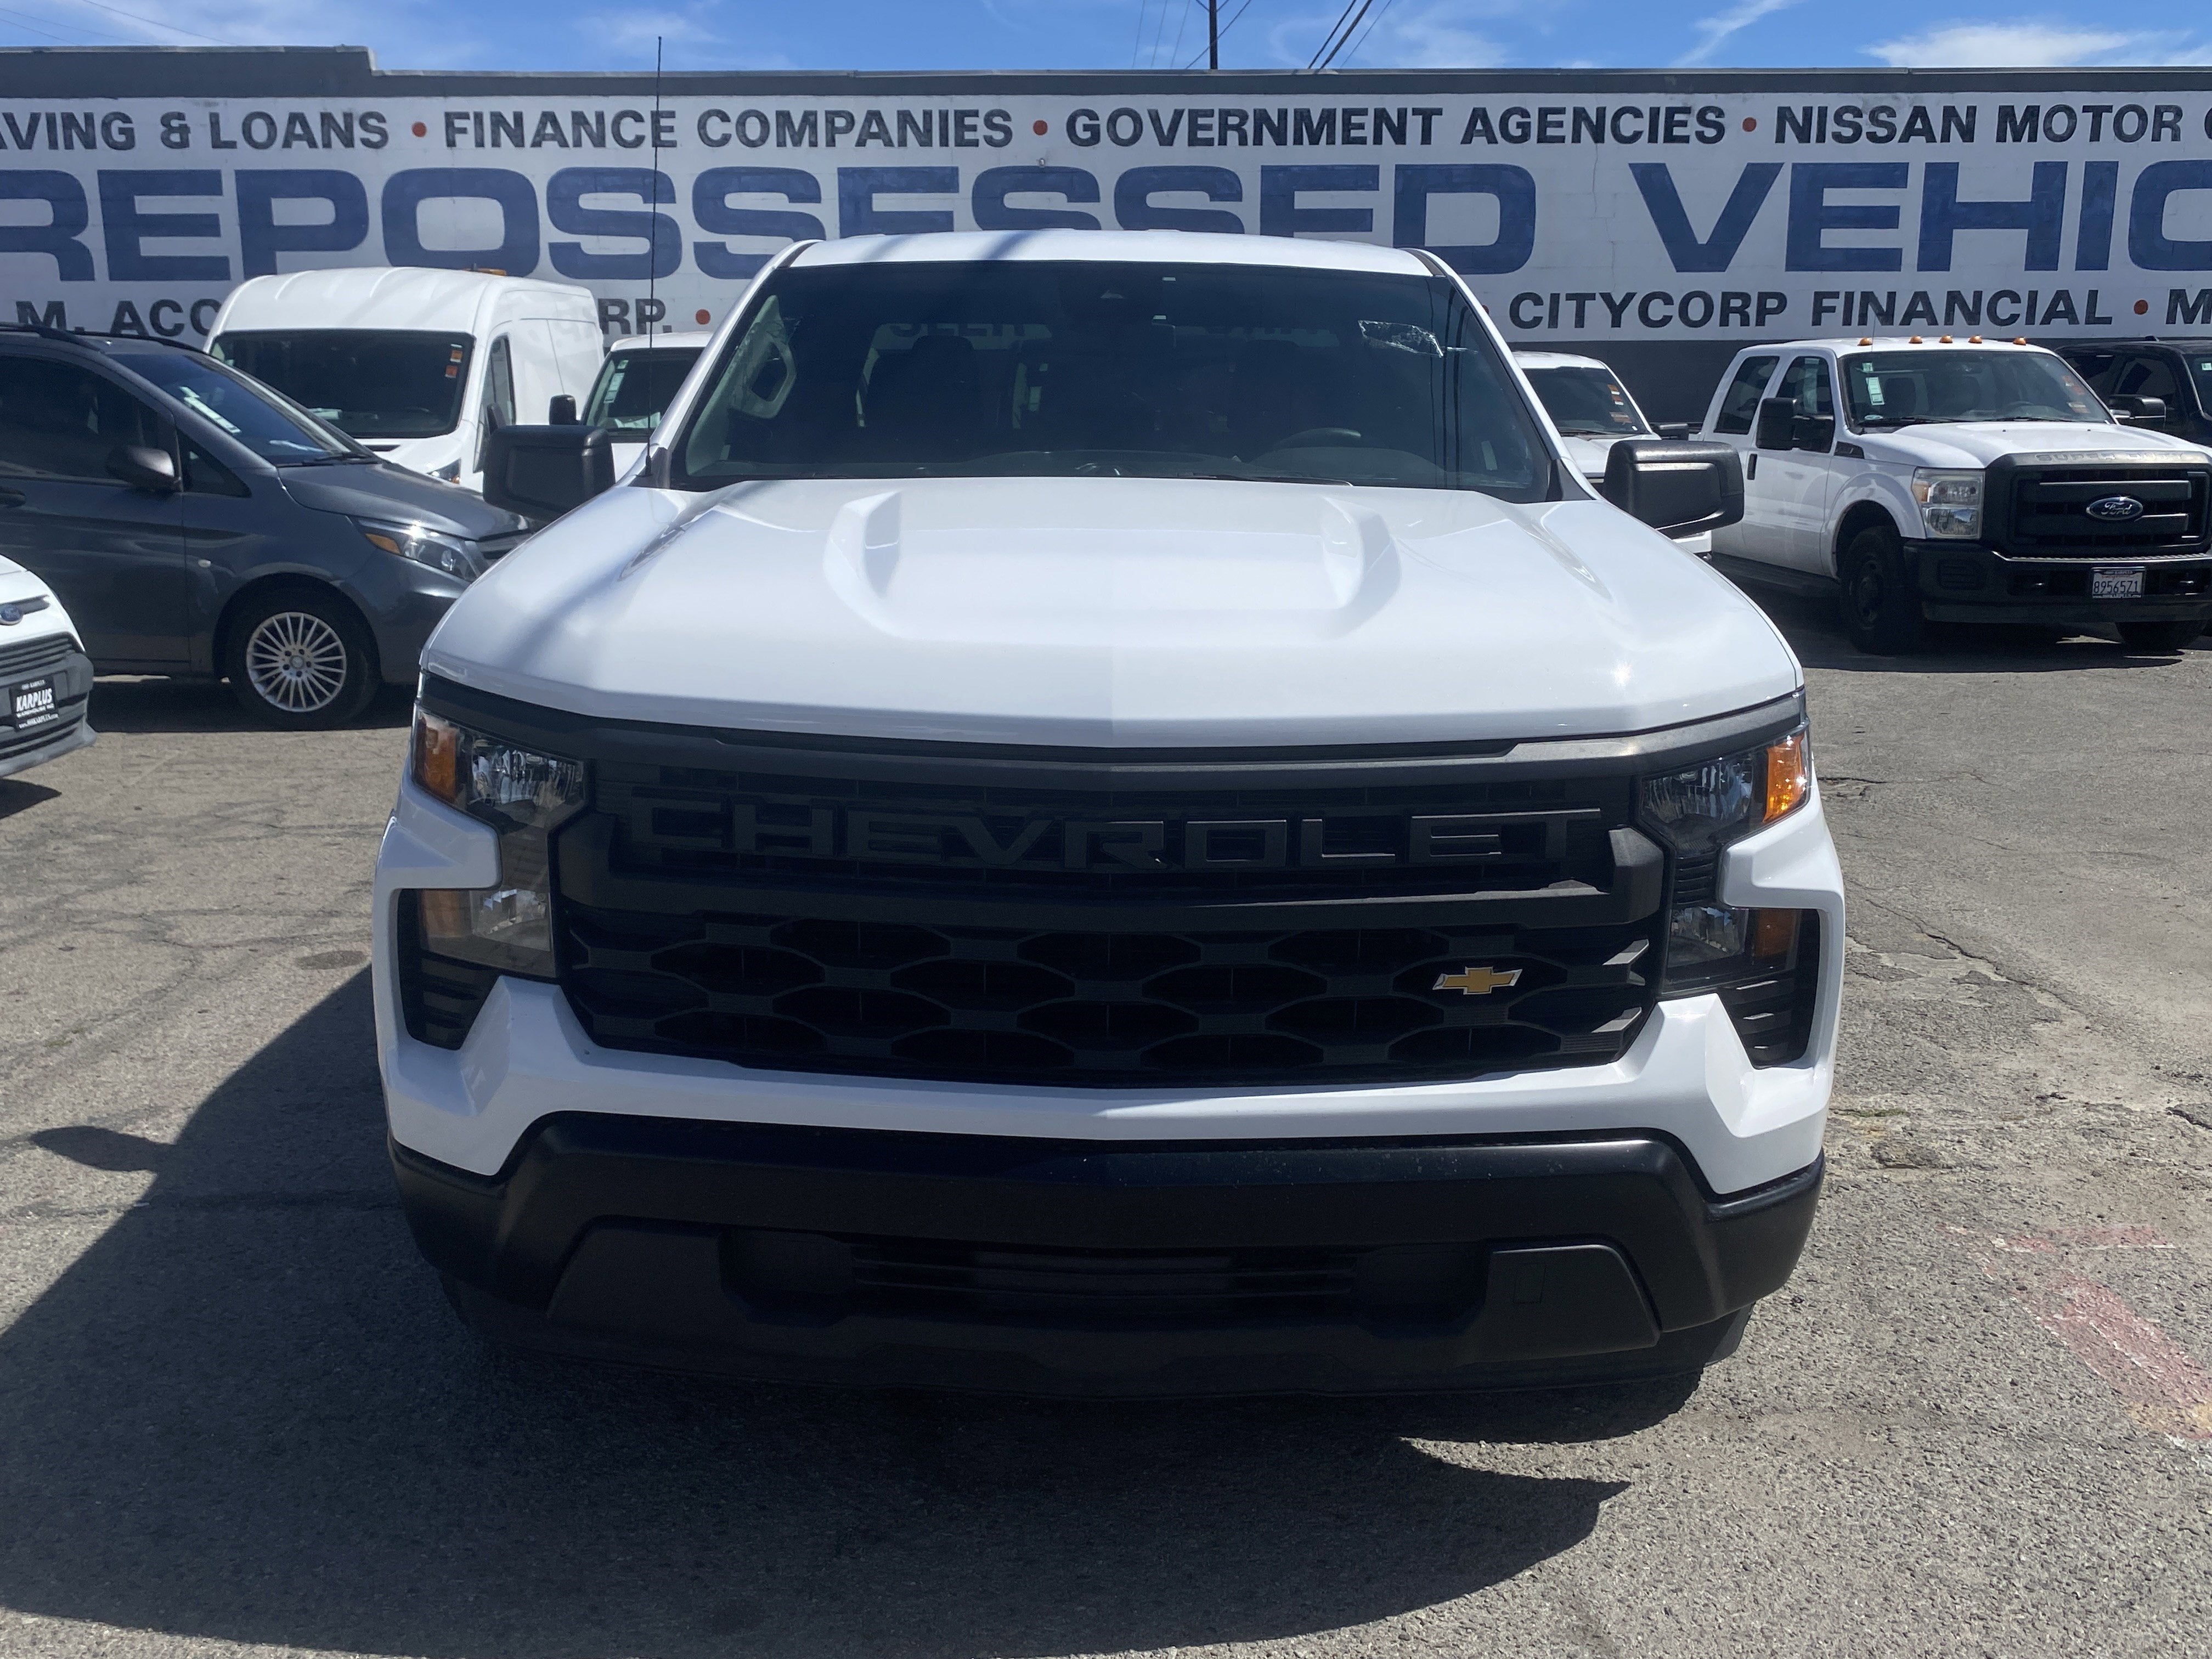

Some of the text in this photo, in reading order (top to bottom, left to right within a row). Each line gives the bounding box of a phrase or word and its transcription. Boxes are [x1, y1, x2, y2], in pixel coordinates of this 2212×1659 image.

[0, 111, 136, 150] VING
[161, 111, 190, 149] &
[210, 111, 389, 150] LOANS
[444, 110, 678, 148] FINANCE
[697, 108, 1013, 148] COMPANIES
[1066, 107, 1443, 147] GOVERNMENT
[1460, 105, 1726, 145] AGENCIES
[1775, 105, 1977, 144] NISSAN
[1995, 104, 2183, 143] MOTOR
[1628, 159, 2212, 273] VEHIC
[1509, 291, 1788, 329] CITYCORP
[1811, 289, 2113, 326] FINANCIAL
[2101, 501, 2133, 515] Ford
[16, 688, 53, 712] KARPLUS
[631, 795, 1601, 871] CHEVROLET
